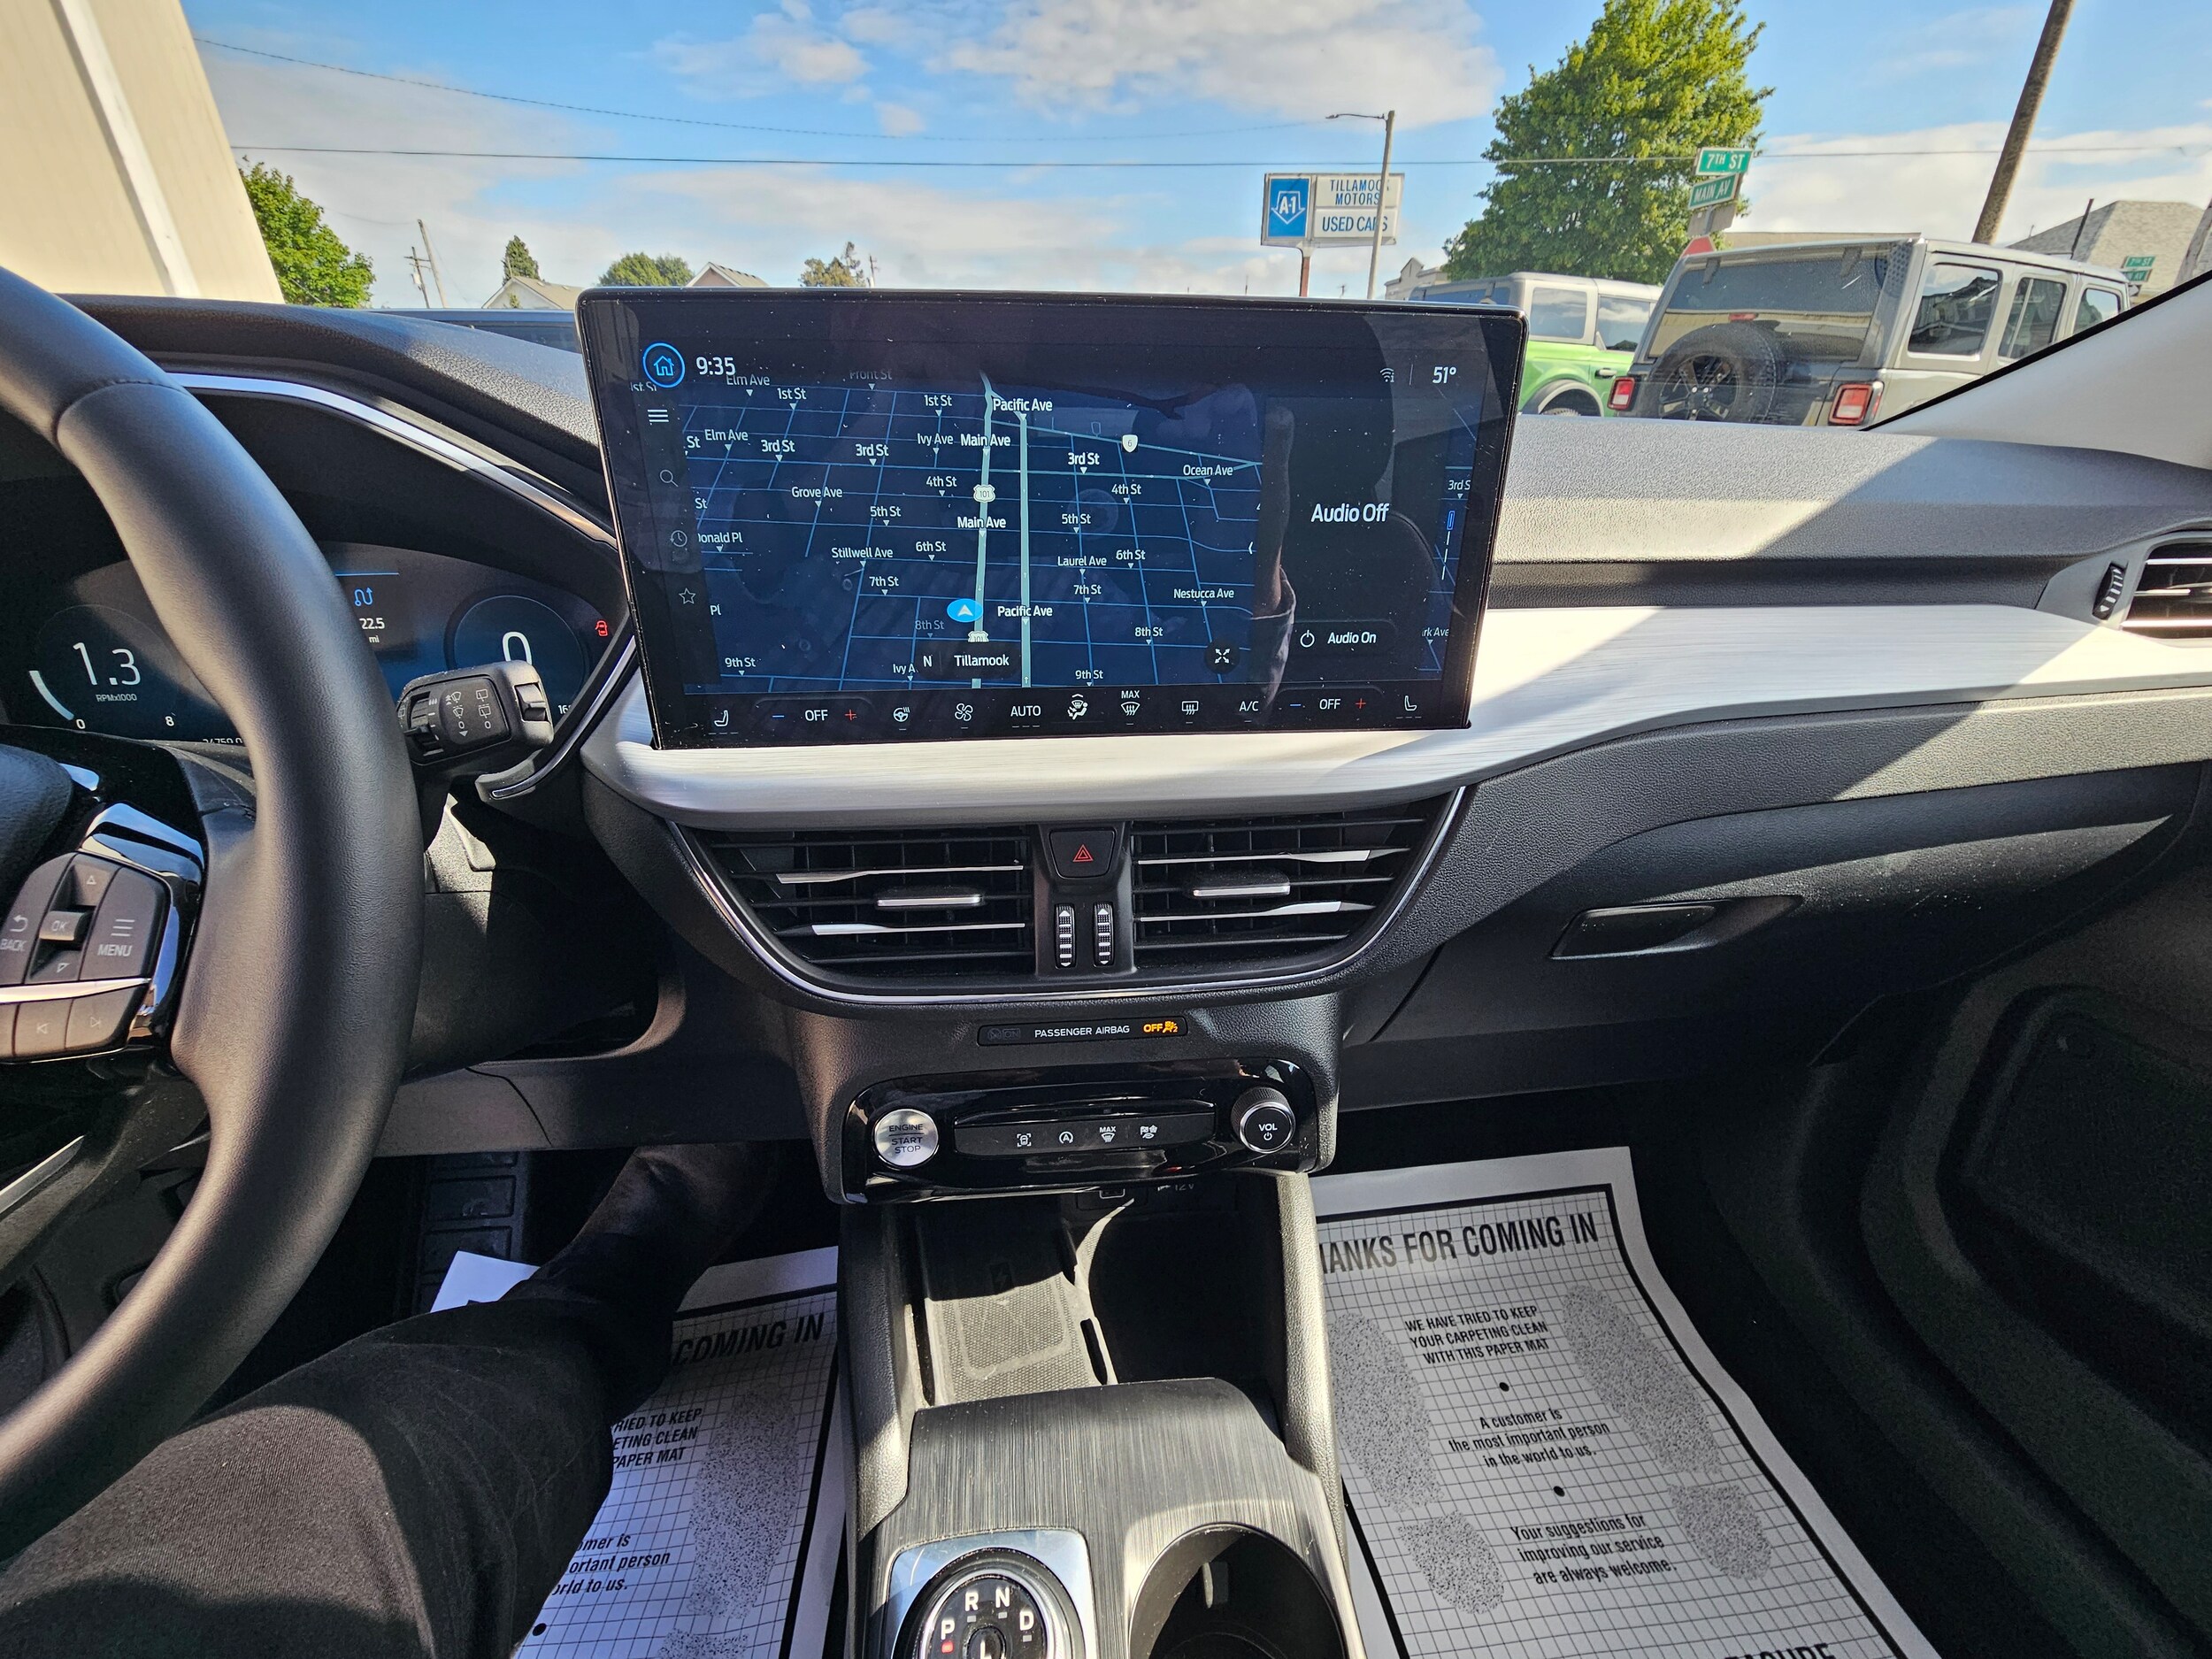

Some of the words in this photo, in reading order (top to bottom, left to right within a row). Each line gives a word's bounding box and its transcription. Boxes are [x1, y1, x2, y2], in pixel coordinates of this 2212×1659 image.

[1707, 154, 1725, 168] 7TH
[1729, 154, 1745, 170] ST
[1331, 179, 1389, 191] TILLAMOO
[1694, 184, 1717, 203] MAIN
[1717, 180, 1731, 199] AV
[1335, 192, 1380, 205] MOTORS
[1322, 216, 1354, 232] USED
[696, 357, 736, 375] 9:35
[726, 375, 749, 386] Elm
[750, 375, 770, 386] Ave
[778, 388, 791, 400] 1st
[793, 388, 806, 400] St
[925, 395, 938, 406] 1st
[940, 395, 952, 406] St
[993, 399, 1030, 411] Pacific
[1032, 399, 1053, 411] Ave
[704, 430, 726, 441] Elm
[728, 430, 749, 441] Ave
[918, 434, 933, 446] Ivy
[934, 434, 954, 444] Ave
[961, 434, 987, 446] Main
[989, 435, 1010, 446] Ave
[687, 436, 701, 449] St
[761, 440, 778, 452] 3rd
[780, 441, 795, 453] St
[856, 444, 872, 457] 3rd
[874, 444, 888, 457] St
[1068, 453, 1084, 465] 3rd
[1085, 453, 1100, 465] St
[1184, 465, 1212, 476] Ocean
[1214, 465, 1233, 475] Ave
[926, 476, 942, 487] 4th
[944, 476, 957, 487] St
[1448, 480, 1463, 490] 3rd
[791, 488, 821, 497] Grove
[823, 487, 842, 497] Ave
[1111, 485, 1127, 495] 4th
[1129, 485, 1141, 495] St
[871, 506, 886, 517] 5th
[888, 506, 901, 517] St
[1311, 503, 1359, 522] Audio
[1363, 503, 1389, 522] Off
[957, 517, 984, 528] Main
[986, 517, 1006, 528] Ave
[1062, 513, 1077, 524] 5th
[1078, 513, 1090, 524] St
[732, 532, 743, 543] Pl
[832, 547, 872, 557] Stillwell
[874, 547, 893, 557] Ave
[916, 541, 933, 552] 6th
[934, 541, 946, 552] St
[1117, 550, 1133, 559] 6th
[1135, 550, 1145, 559] St
[1058, 556, 1087, 566] Laurel
[1088, 556, 1106, 566] Ave
[869, 577, 885, 586] 7th
[887, 577, 899, 586] St
[1074, 585, 1088, 595] 7th
[1090, 585, 1101, 595] St
[1173, 589, 1214, 598] Nestucca
[1217, 589, 1234, 598] Ave
[998, 605, 1031, 617] Pacific
[1033, 605, 1053, 617] Ave
[359, 618, 385, 630] 22.5
[915, 619, 932, 630] 8th
[934, 619, 944, 630] St
[1134, 626, 1152, 637] 8th
[1154, 626, 1163, 637] St
[1327, 632, 1357, 644] Audio
[1361, 632, 1377, 644] On
[73, 642, 142, 686] 1.3
[726, 657, 741, 667] 9th
[744, 657, 756, 667] St
[924, 656, 933, 667] N
[954, 654, 1009, 666] Tillamook
[894, 664, 907, 674] Ivy
[1076, 670, 1093, 680] 9th
[1094, 670, 1103, 680] St
[1121, 690, 1140, 699] MAX
[1239, 701, 1258, 711] A/C
[1319, 699, 1340, 710] OFF
[805, 710, 828, 721] OFF
[1010, 706, 1041, 717] AUTO
[51, 921, 69, 931] OK
[97, 944, 133, 956] MENU
[1035, 1026, 1092, 1038] PASSENGER
[1095, 1025, 1129, 1035] AIRBAG
[1143, 1023, 1163, 1033] OFF
[888, 1124, 924, 1133] ENGINE
[1258, 1123, 1278, 1132] VOL
[892, 1136, 924, 1146] START
[895, 1145, 921, 1154] STOP
[1402, 1228, 1457, 1265] FOR
[1463, 1216, 1565, 1258] COMING
[1570, 1212, 1600, 1244] IN
[1405, 1319, 1423, 1333] WE
[1426, 1315, 1456, 1329] HAVE
[1457, 1311, 1490, 1325] TRIED
[1492, 1309, 1509, 1322] TO
[1509, 1305, 1538, 1320] KEEP
[672, 1321, 787, 1365] COMING
[795, 1312, 825, 1343] IN
[1409, 1333, 1444, 1348] YOUR
[1446, 1325, 1509, 1346] CARPETING
[1511, 1321, 1548, 1338] CLEAN
[1424, 1349, 1456, 1364] WITH
[1457, 1345, 1485, 1361] THIS
[1486, 1341, 1524, 1357] PAPER
[1526, 1338, 1549, 1353] MAT
[649, 1414, 665, 1428] TO
[669, 1409, 703, 1425] KEEP
[1492, 1412, 1545, 1428] customer
[1548, 1409, 1563, 1420] is
[656, 1426, 698, 1444] CLEAN
[1448, 1439, 1470, 1453] the
[1473, 1436, 1505, 1451] most
[1506, 1426, 1568, 1449] important
[1570, 1422, 1610, 1442] person
[612, 1451, 653, 1469] PAPER
[657, 1447, 687, 1463] MAT
[1485, 1455, 1498, 1467] in
[1501, 1453, 1520, 1467] the
[1521, 1448, 1555, 1464] world
[1558, 1446, 1574, 1460] to
[1576, 1444, 1597, 1458] us.
[1510, 1525, 1543, 1542] Your
[1545, 1516, 1624, 1541] suggestions
[1624, 1513, 1647, 1528] for
[617, 1533, 631, 1548] is
[1518, 1543, 1590, 1563] improving
[1592, 1541, 1614, 1556] our
[1615, 1535, 1665, 1553] service
[617, 1552, 671, 1572] person
[1533, 1571, 1557, 1586] are
[1559, 1563, 1609, 1584] always
[1609, 1557, 1678, 1578] welcome.
[586, 1578, 602, 1593] to
[606, 1578, 628, 1591] us.
[964, 1591, 979, 1612] R
[995, 1587, 1010, 1608] N
[1019, 1610, 1034, 1632] D
[941, 1619, 956, 1640] P
